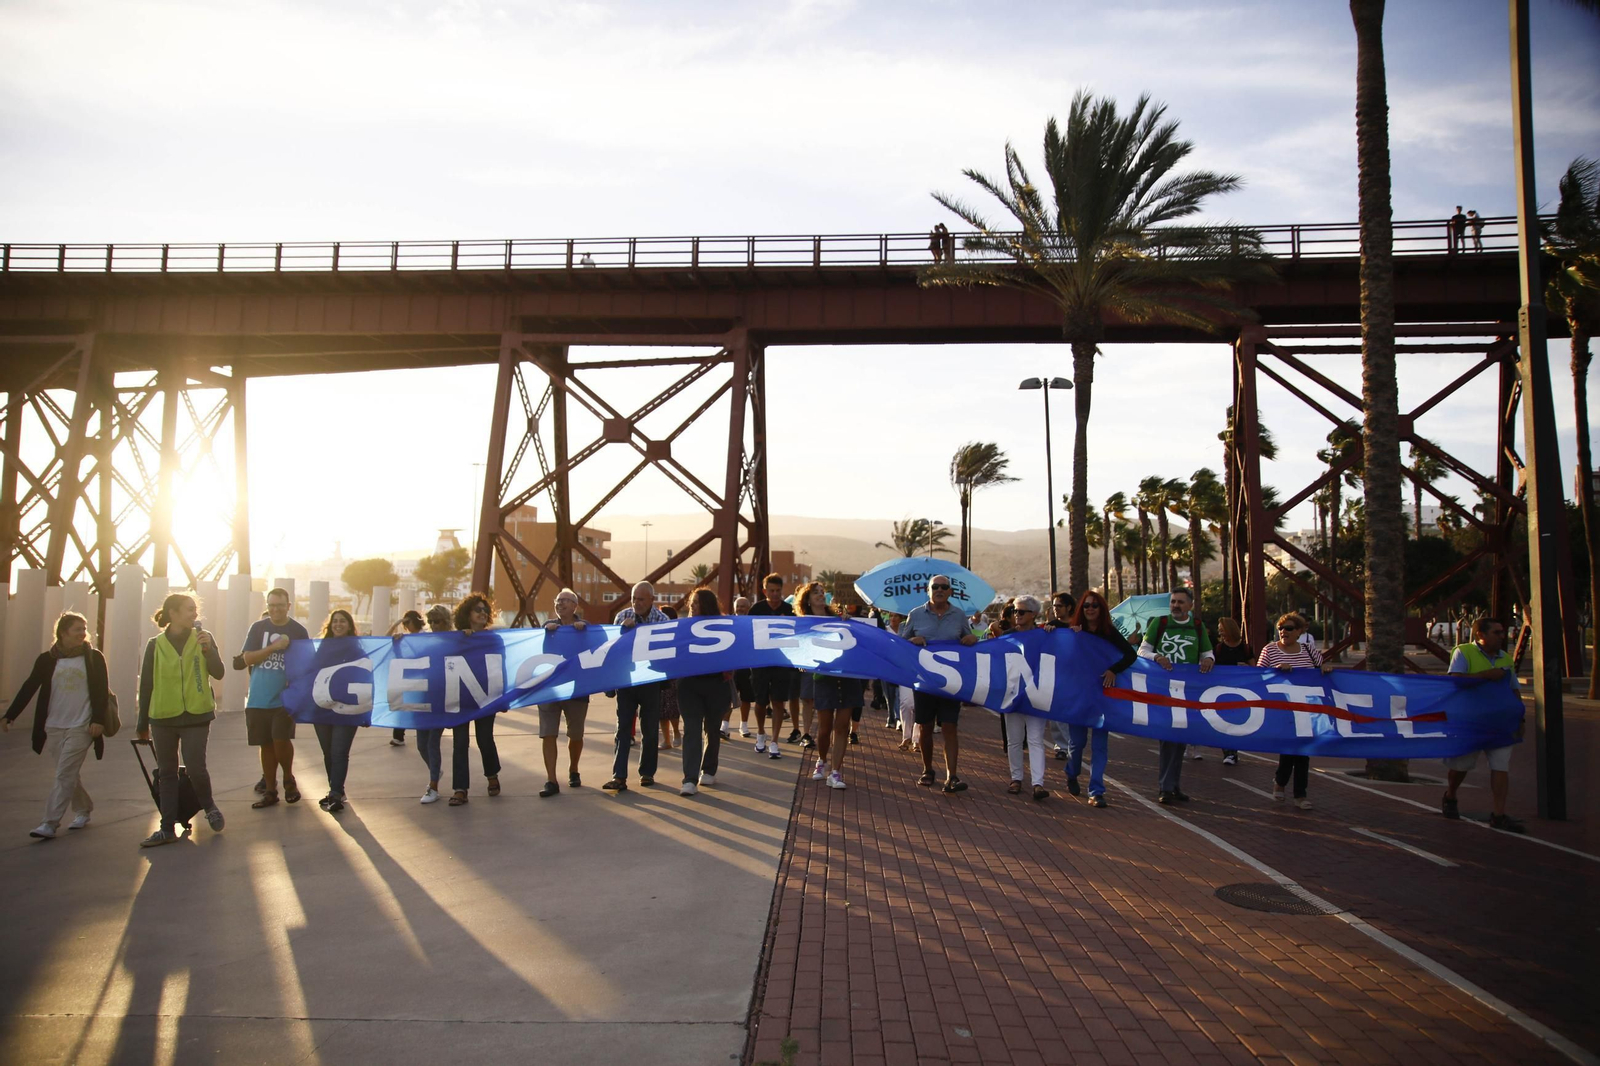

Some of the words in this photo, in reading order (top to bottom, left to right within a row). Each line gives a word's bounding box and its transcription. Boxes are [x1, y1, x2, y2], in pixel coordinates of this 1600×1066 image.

[884, 573, 966, 589] GENOVES
[884, 584, 911, 597] SIN
[914, 582, 970, 601] HEL
[919, 648, 1056, 712] SIN
[1131, 672, 1447, 738] HOTEL
